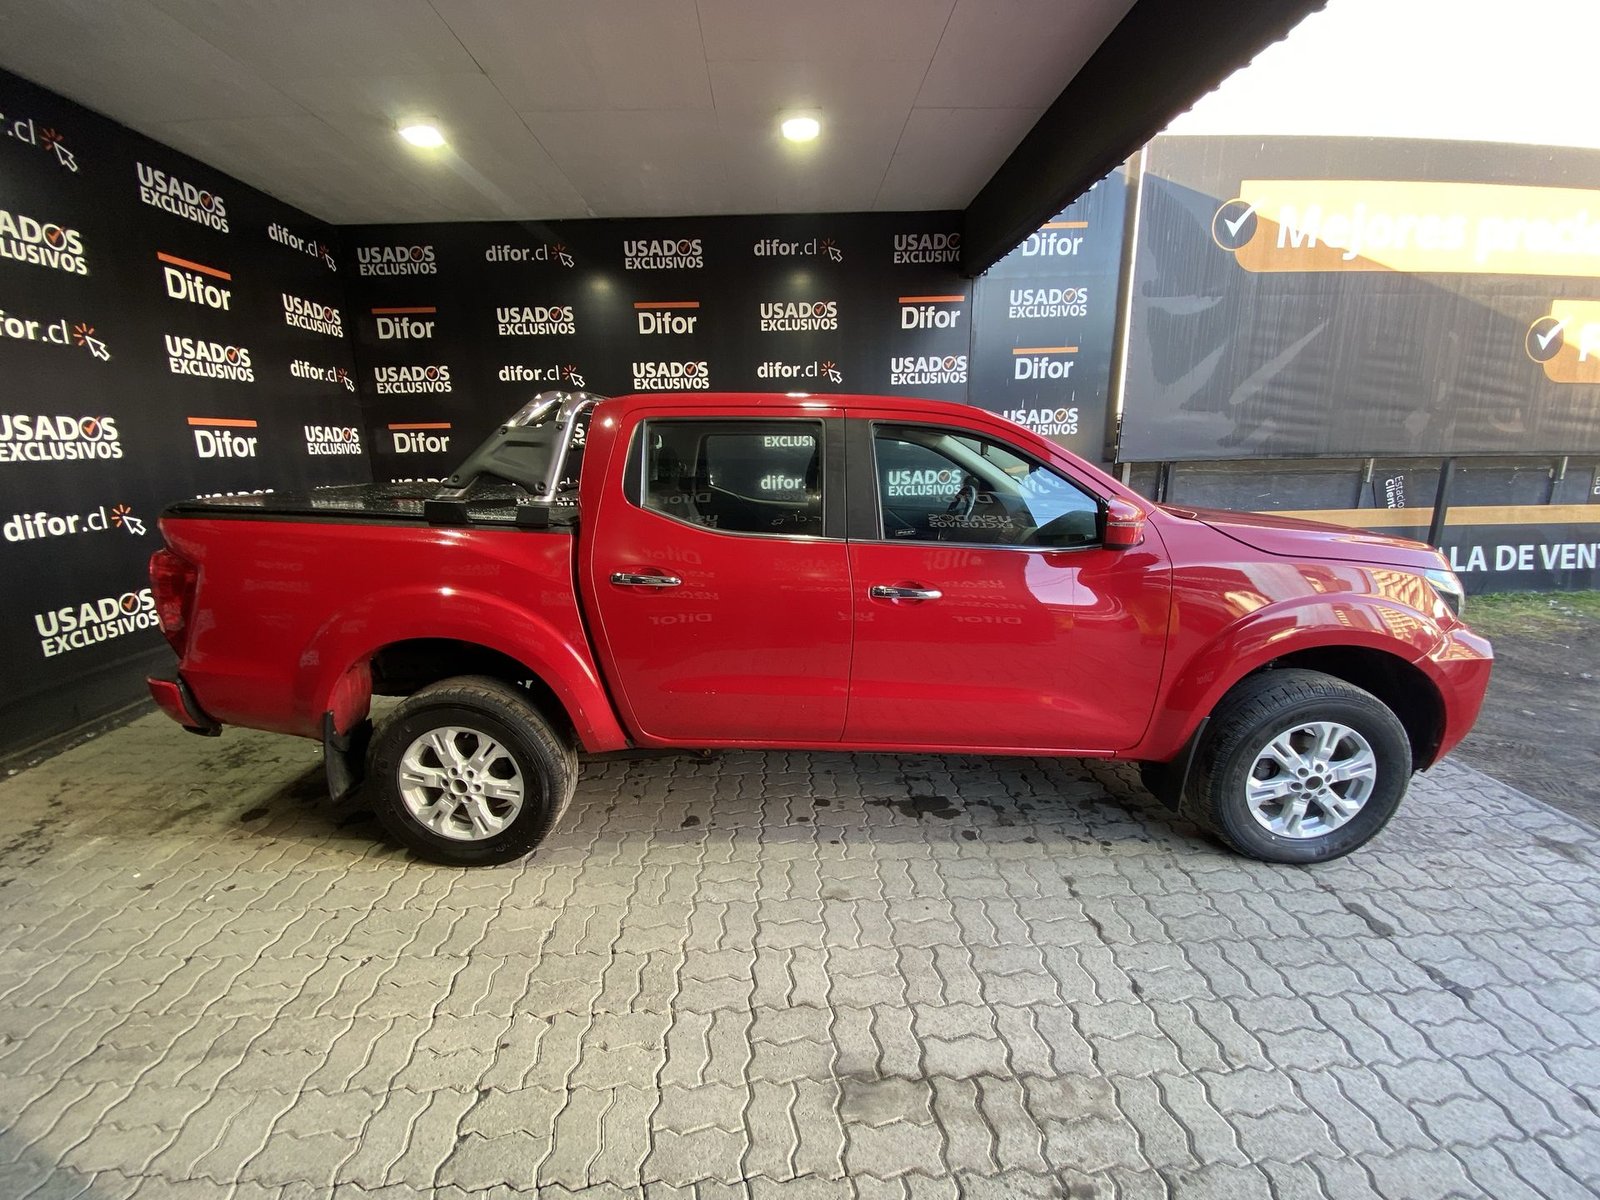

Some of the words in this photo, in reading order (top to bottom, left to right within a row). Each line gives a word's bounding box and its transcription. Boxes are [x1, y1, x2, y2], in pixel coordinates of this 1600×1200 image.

[136, 162, 227, 217] USADOS
[140, 186, 230, 234] EXCLUSIVOS
[267, 223, 319, 258] difor.cl
[1276, 204, 1467, 261] Mejores
[485, 244, 548, 262] difor.cl
[624, 239, 702, 256] USADOS
[753, 238, 817, 256] difor.cl
[1022, 232, 1083, 256] Difor
[357, 246, 435, 263] USADOS
[624, 256, 704, 269] EXCLUSIVOS
[360, 262, 437, 275] EXCLUSIVOS
[164, 267, 231, 310] Difor
[1010, 287, 1088, 305] USADOS
[282, 293, 341, 326] USADOS
[496, 306, 574, 323] USADOS
[760, 301, 838, 319] USADOS
[901, 306, 961, 329] Difor
[1009, 305, 1087, 319] EXCLUSIVOS
[286, 315, 344, 338] EXCLUSIVOS
[376, 317, 435, 339] Difor
[498, 322, 576, 335] EXCLUSIVOS
[638, 312, 697, 334] Difor
[760, 318, 838, 331] EXCLUSIVOS
[165, 335, 252, 369] USADOS
[170, 359, 255, 383] EXCLUSIVOS
[290, 360, 338, 383] difor.cl
[632, 361, 708, 379] USADOS
[757, 362, 818, 379] difor.cl
[891, 355, 967, 373] USADOS
[1014, 357, 1075, 380] Difor
[374, 365, 450, 382] USADOS
[498, 365, 560, 382] difor.cl
[890, 371, 967, 385] EXCLUSIVOS
[376, 381, 452, 394] EXCLUSIVOS
[633, 377, 710, 390] EXCLUSIVOS
[304, 425, 360, 444] USADOS
[393, 432, 450, 453] Difor
[764, 435, 815, 447] EXCLUSI
[195, 430, 257, 458] Difor
[307, 442, 362, 455] EXCLUSIVOS
[888, 469, 961, 485] USADOS
[888, 484, 961, 496] EXCLUSIVOS
[3, 506, 108, 542] difor.cl
[1438, 545, 1488, 572] LA
[1496, 545, 1534, 571] DE
[1540, 543, 1600, 570] VEN
[35, 588, 155, 637] USADOS
[41, 609, 159, 657] EXCLUSIVOS
